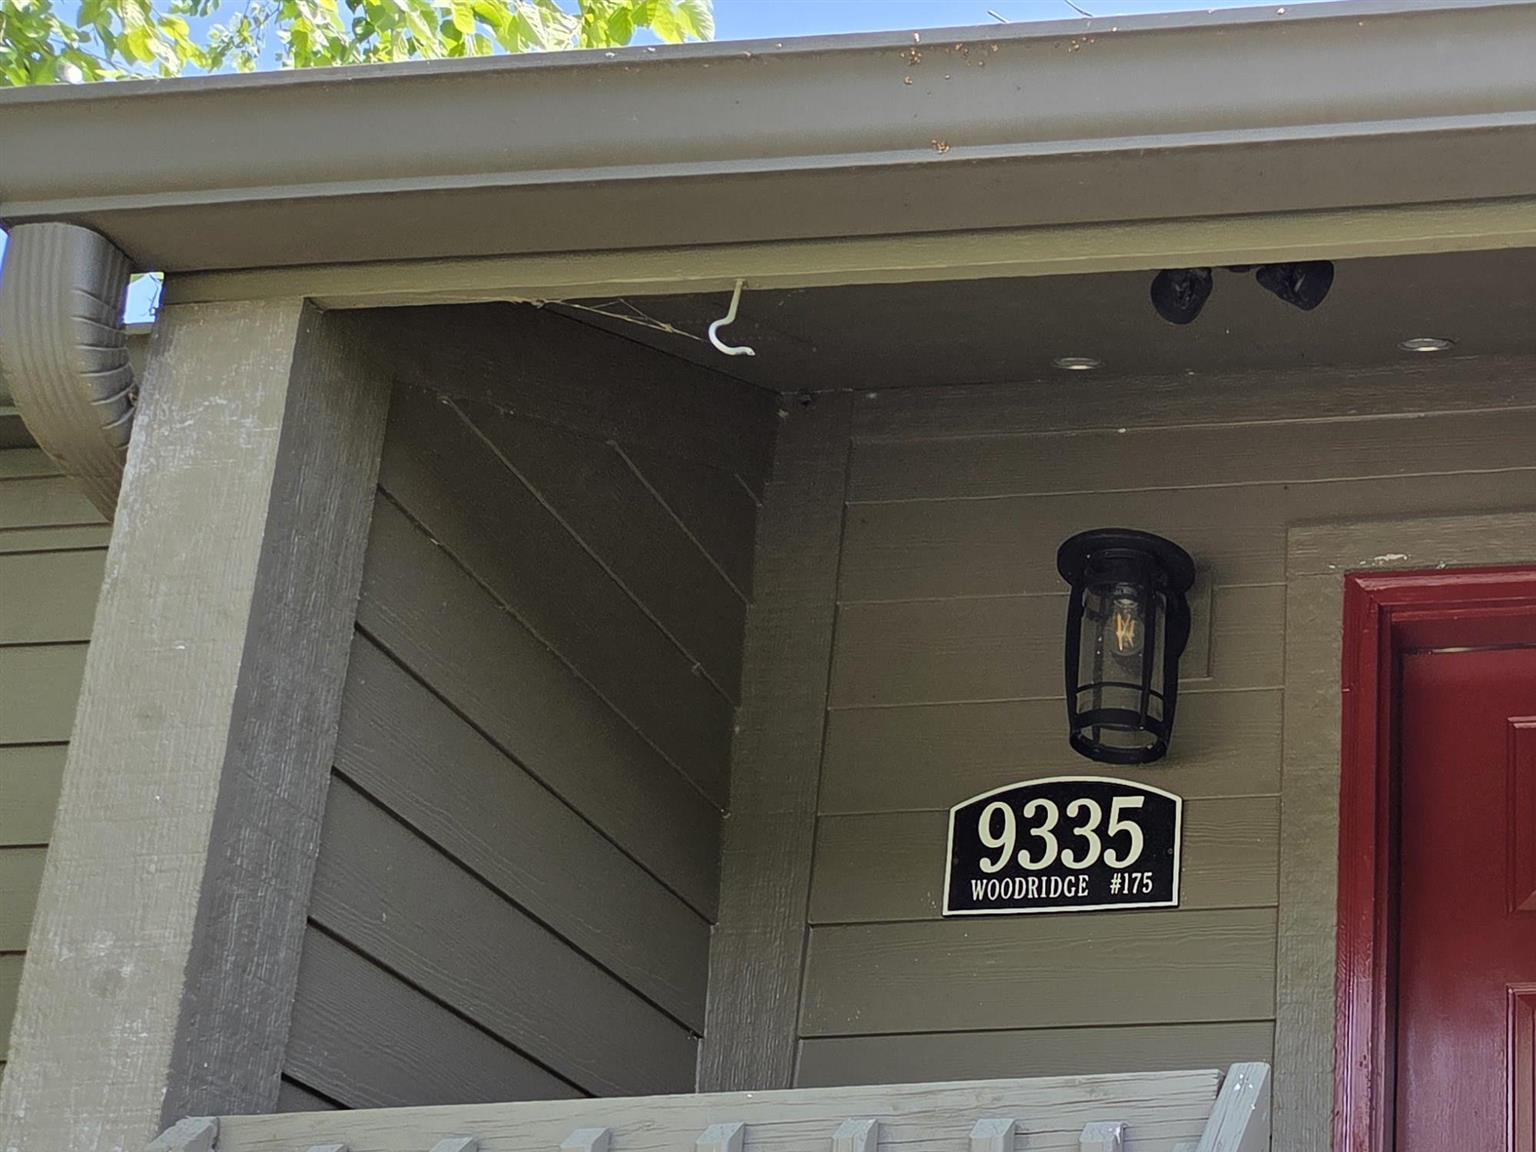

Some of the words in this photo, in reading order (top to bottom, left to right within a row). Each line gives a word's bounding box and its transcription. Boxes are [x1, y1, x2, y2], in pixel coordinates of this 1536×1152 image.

[978, 796, 1145, 873] 9335
[971, 874, 1089, 901] WOODRIDGE
[1109, 872, 1153, 895] #175
